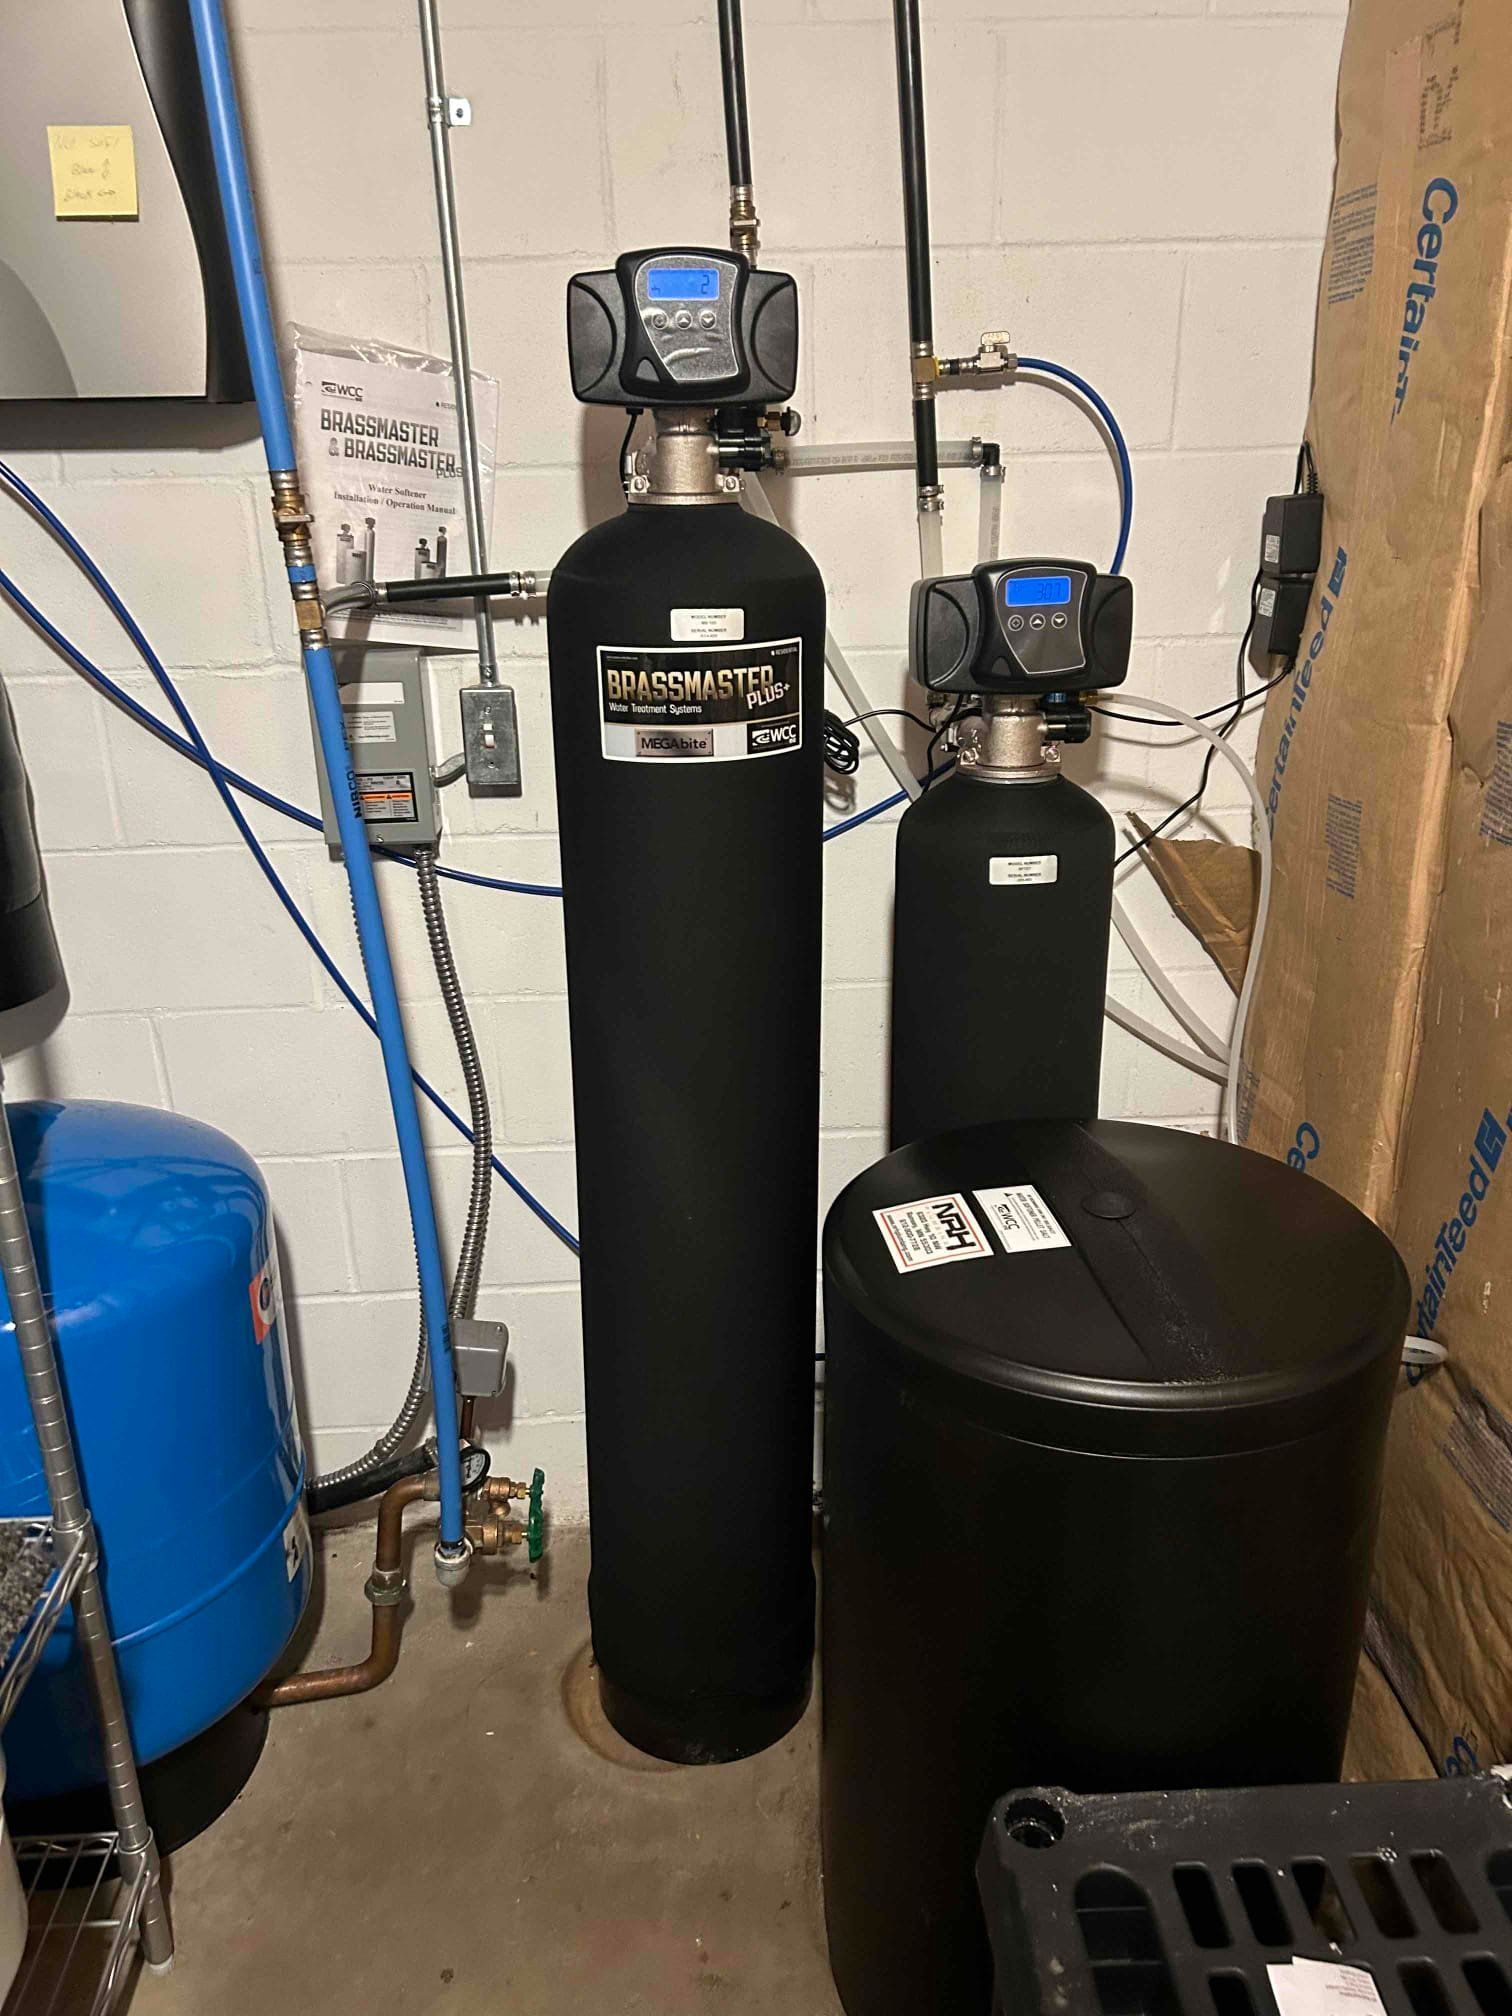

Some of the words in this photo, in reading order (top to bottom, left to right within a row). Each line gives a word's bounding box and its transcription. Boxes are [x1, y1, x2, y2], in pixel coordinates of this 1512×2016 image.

[700, 274, 711, 295] 2
[337, 383, 364, 399] WCC
[320, 408, 439, 448] BRASSMASTER
[328, 437, 340, 457] &
[344, 437, 456, 474] BRASSMASTER
[368, 483, 393, 495] Water
[394, 487, 427, 499] Softener
[334, 491, 379, 506] Installation
[385, 498, 425, 511] Operation
[426, 503, 456, 515] Manual
[607, 664, 774, 702] BRASSMASTER
[608, 701, 629, 713] Water
[631, 702, 667, 714] Treatment
[669, 703, 703, 716] Systems
[1267, 596, 1334, 840] ertainTeed
[770, 724, 797, 742] WCC
[1001, 1212, 1021, 1230] WCC
